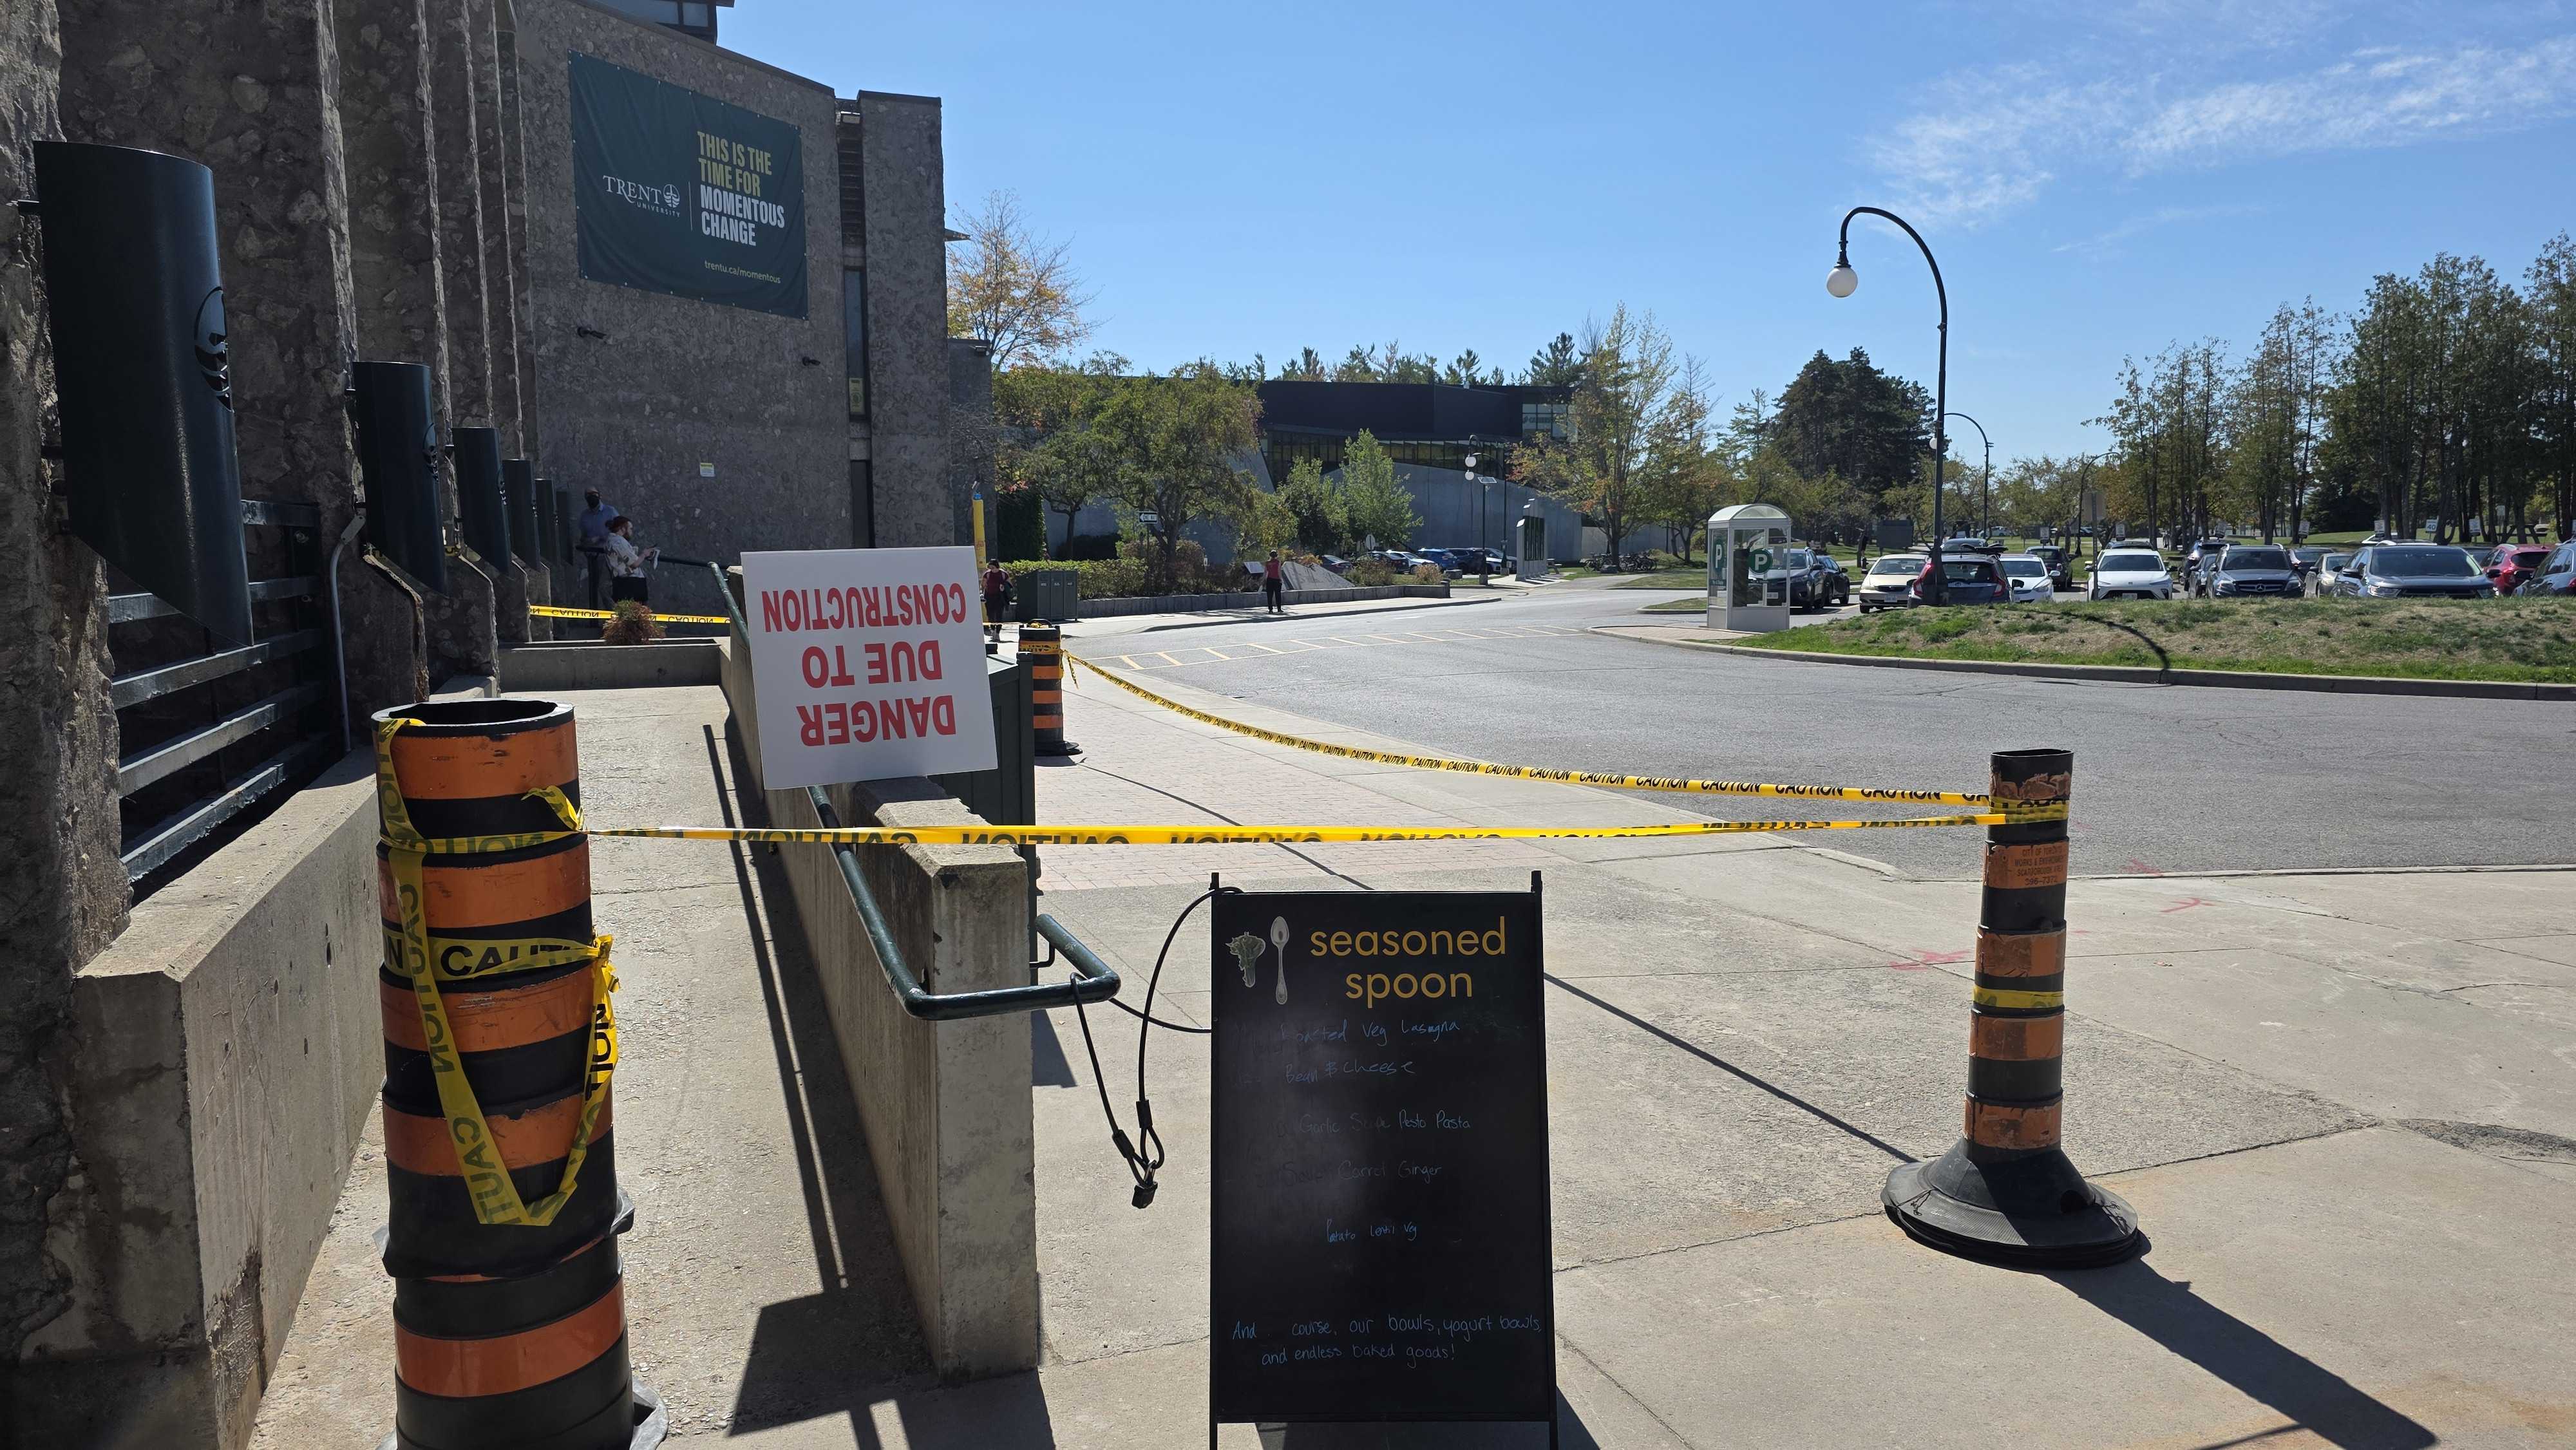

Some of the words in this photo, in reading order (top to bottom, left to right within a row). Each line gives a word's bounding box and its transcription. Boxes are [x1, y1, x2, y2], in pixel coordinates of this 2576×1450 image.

[697, 130, 729, 163] THIS
[732, 141, 746, 167] IS
[748, 146, 772, 176] THE
[603, 174, 663, 204] TRENT
[698, 157, 732, 189] TIME
[735, 169, 761, 196] FOR
[637, 202, 681, 218] UNIVERSITY
[700, 184, 785, 229] MOMENTOUS
[701, 211, 757, 247] CHANGE
[705, 259, 781, 284] trentu.ca/momentous
[1755, 554, 1767, 570] P
[761, 582, 966, 633] CONSTRUCTION
[801, 645, 855, 688] TO
[864, 639, 943, 685] DUE
[796, 695, 956, 747] DANGER
[1275, 735, 1296, 747] CAUTION
[1298, 740, 1321, 751] CAUTION
[1323, 745, 1347, 757] CAUTION
[1350, 749, 1377, 761] CAUTION
[1379, 754, 1408, 765] CAUTION
[1411, 758, 1443, 769] CAUTION
[1446, 761, 1480, 773] CAUTION
[1484, 764, 1522, 777] CAUTION
[1529, 767, 1572, 780] CAUTION
[1578, 771, 1626, 785] CAUTION
[1636, 776, 1690, 789] CAUTION
[1310, 916, 1506, 957] seasoned
[1345, 972, 1472, 1008] spoon
[1362, 1020, 1387, 1046] Veg
[1399, 1108, 1426, 1129] Pesto
[1435, 1109, 1472, 1129] Pasta
[1398, 1160, 1442, 1184] Ginger
[1232, 1321, 1257, 1340] And
[1349, 1318, 1375, 1333] our
[1443, 1315, 1492, 1341] yogurt
[1262, 1349, 1287, 1366] and
[1294, 1344, 1343, 1361] endless
[1352, 1344, 1396, 1358] baked
[1406, 1343, 1455, 1370] goods!
